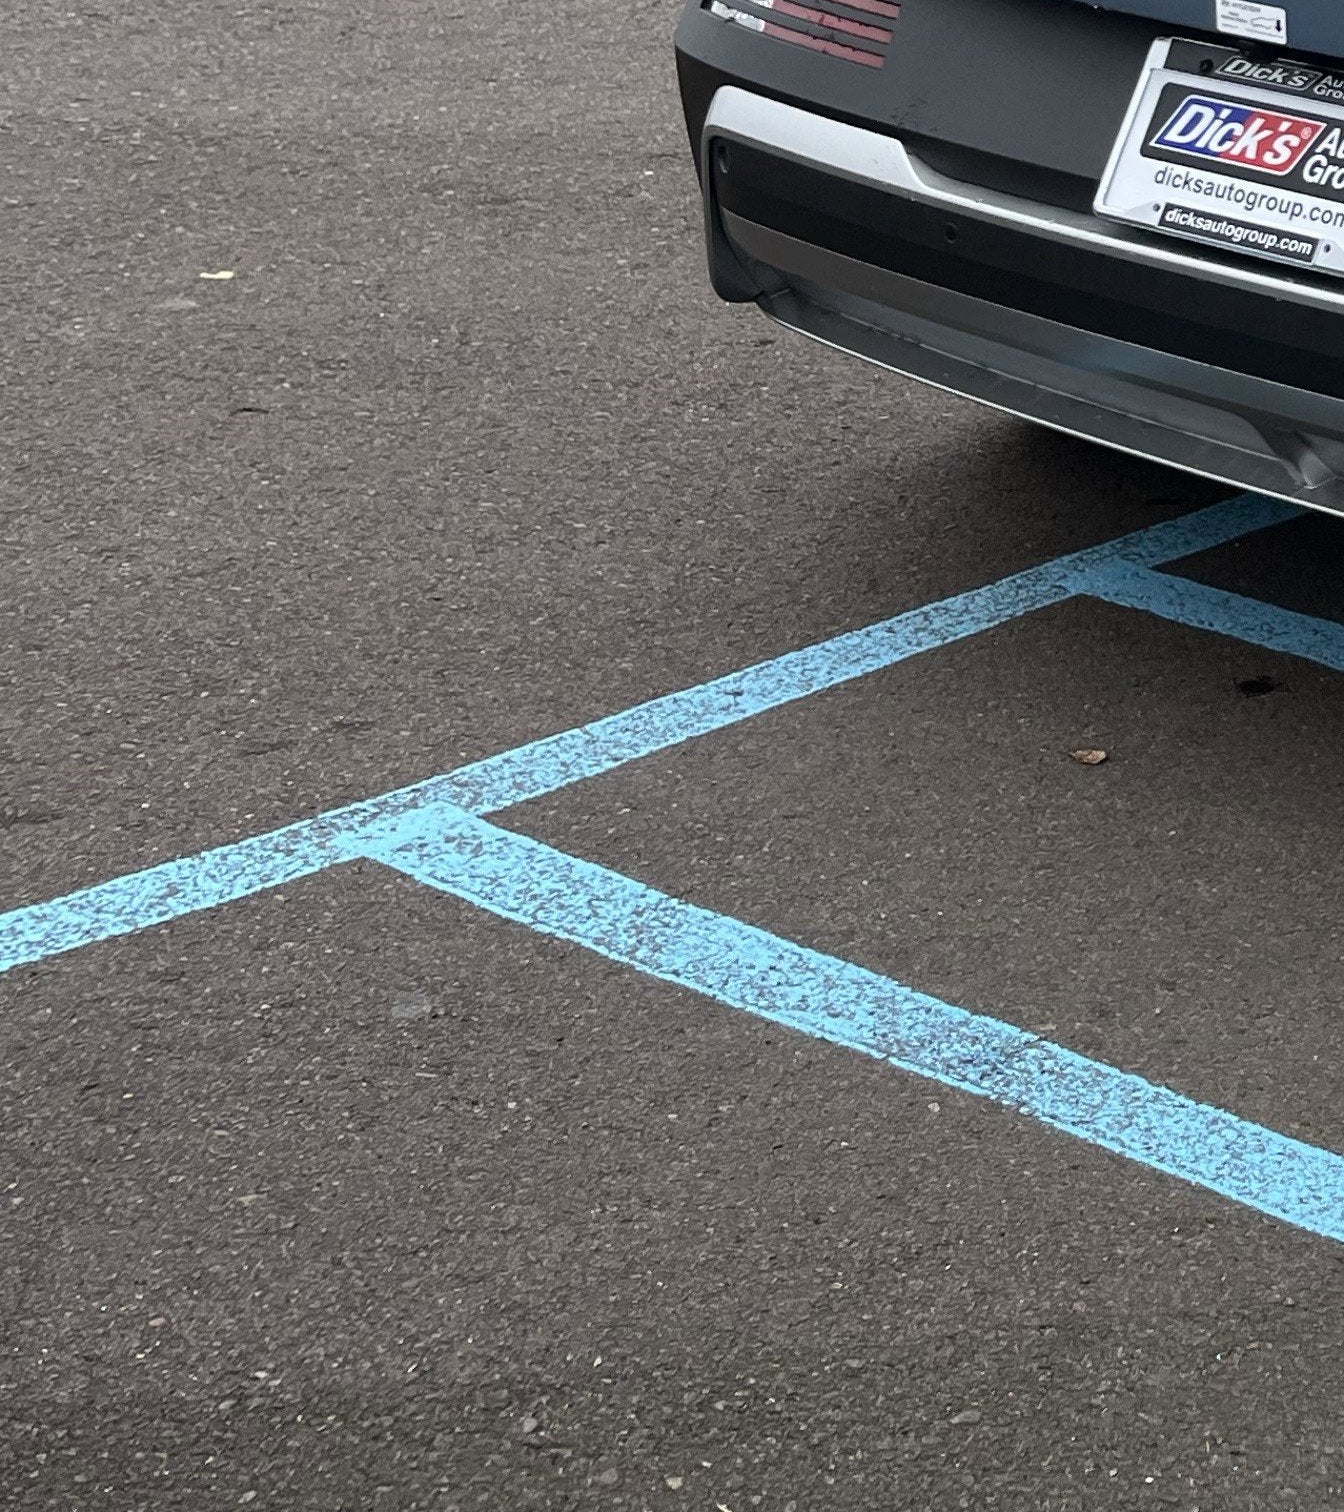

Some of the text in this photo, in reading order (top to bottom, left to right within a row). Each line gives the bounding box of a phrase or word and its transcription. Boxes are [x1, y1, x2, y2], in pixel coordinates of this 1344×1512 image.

[1224, 59, 1309, 88] Dick's
[1163, 103, 1301, 166] Dick's
[1164, 208, 1313, 256] dicksautogroup.com
